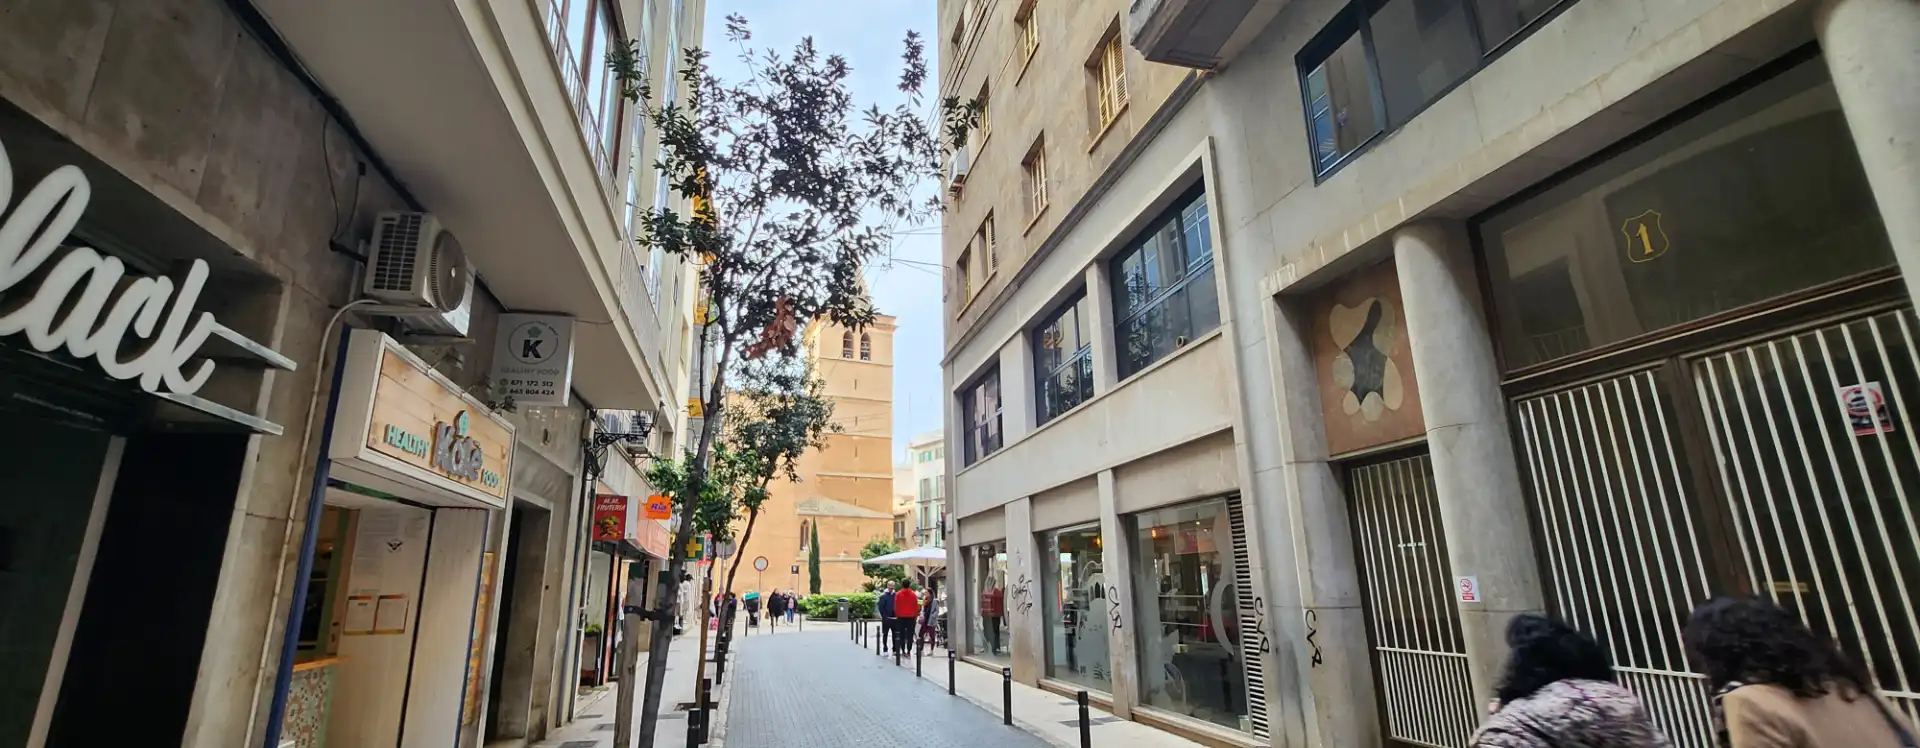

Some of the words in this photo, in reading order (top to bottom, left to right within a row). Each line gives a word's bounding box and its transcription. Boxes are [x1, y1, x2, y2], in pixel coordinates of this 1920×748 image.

[1636, 223, 1654, 255] 1
[522, 339, 543, 359] K
[384, 423, 430, 459] HEALTHY
